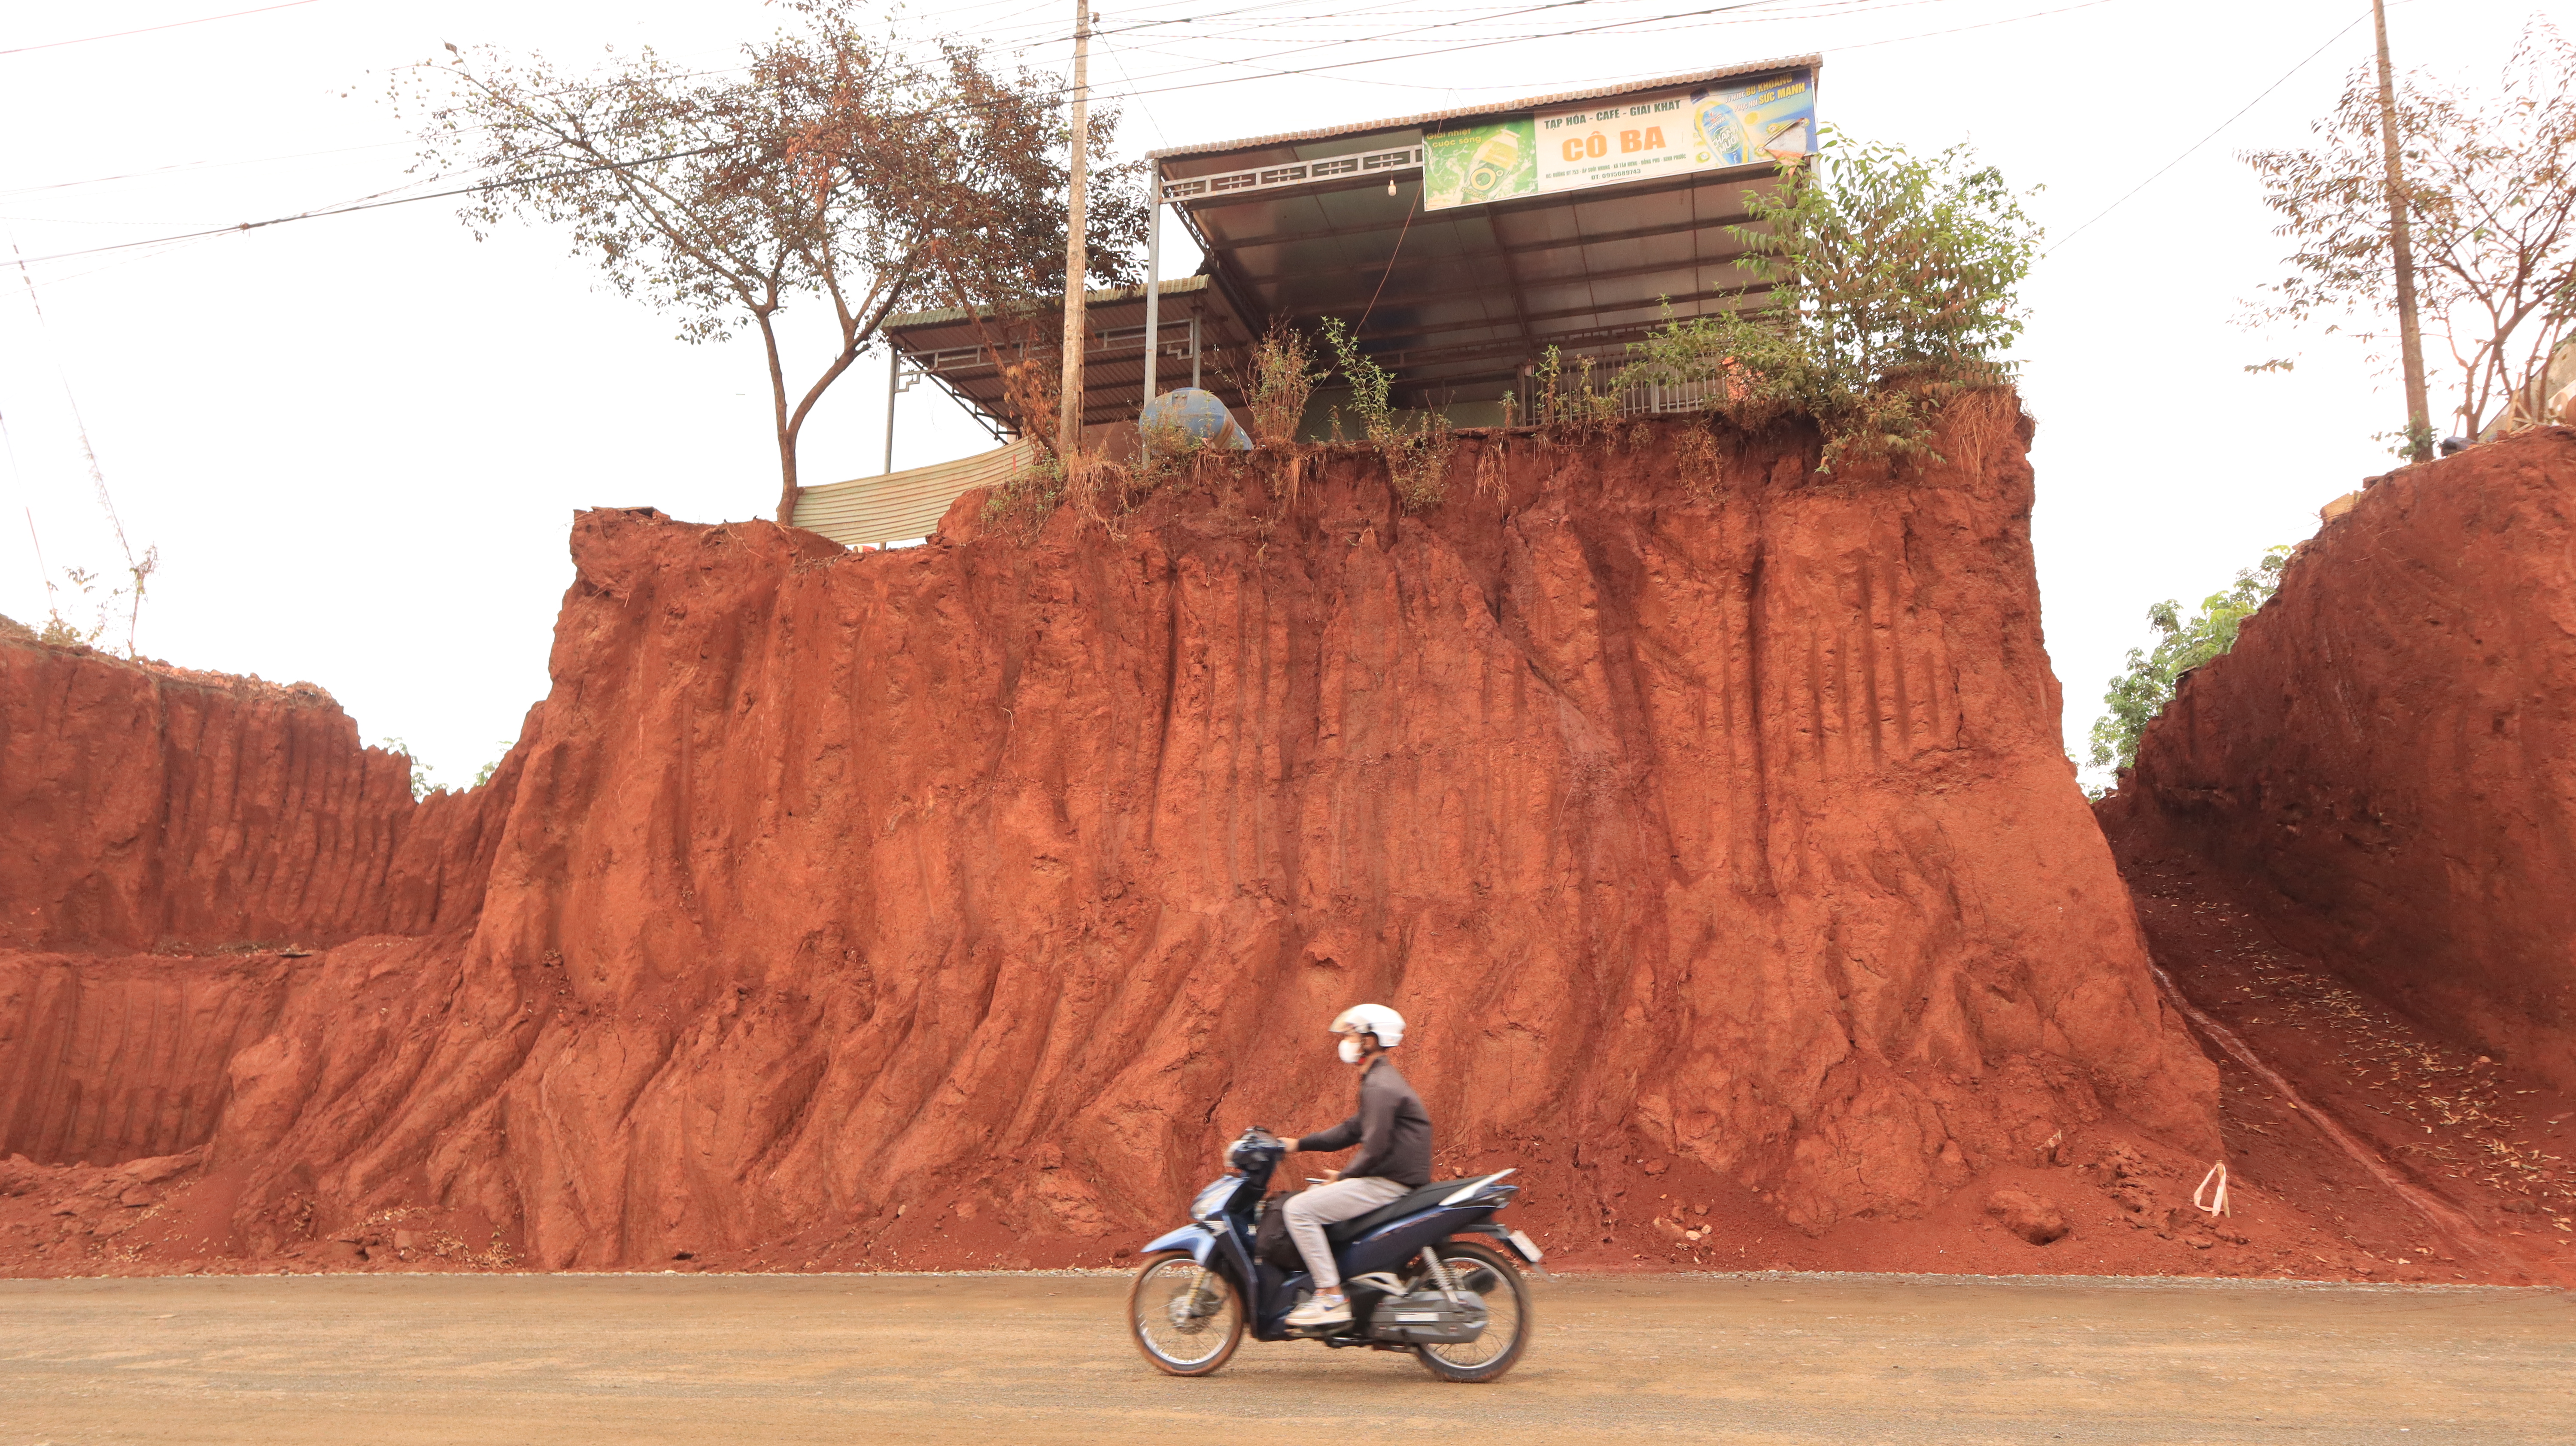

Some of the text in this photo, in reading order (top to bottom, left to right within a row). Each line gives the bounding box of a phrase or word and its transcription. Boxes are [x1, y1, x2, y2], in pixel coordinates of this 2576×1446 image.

[1759, 91, 1775, 104] SỨC
[1777, 82, 1806, 99] MẠNH
[1544, 118, 1563, 130] TẠP
[1566, 114, 1586, 126] HÓA
[1596, 108, 1620, 121] CAFÉ
[1432, 140, 1455, 148] cuộc
[1562, 126, 1666, 161] CÔ BA
[1602, 169, 1641, 178] 0915689743
[1461, 187, 1479, 197] KHÔNG
